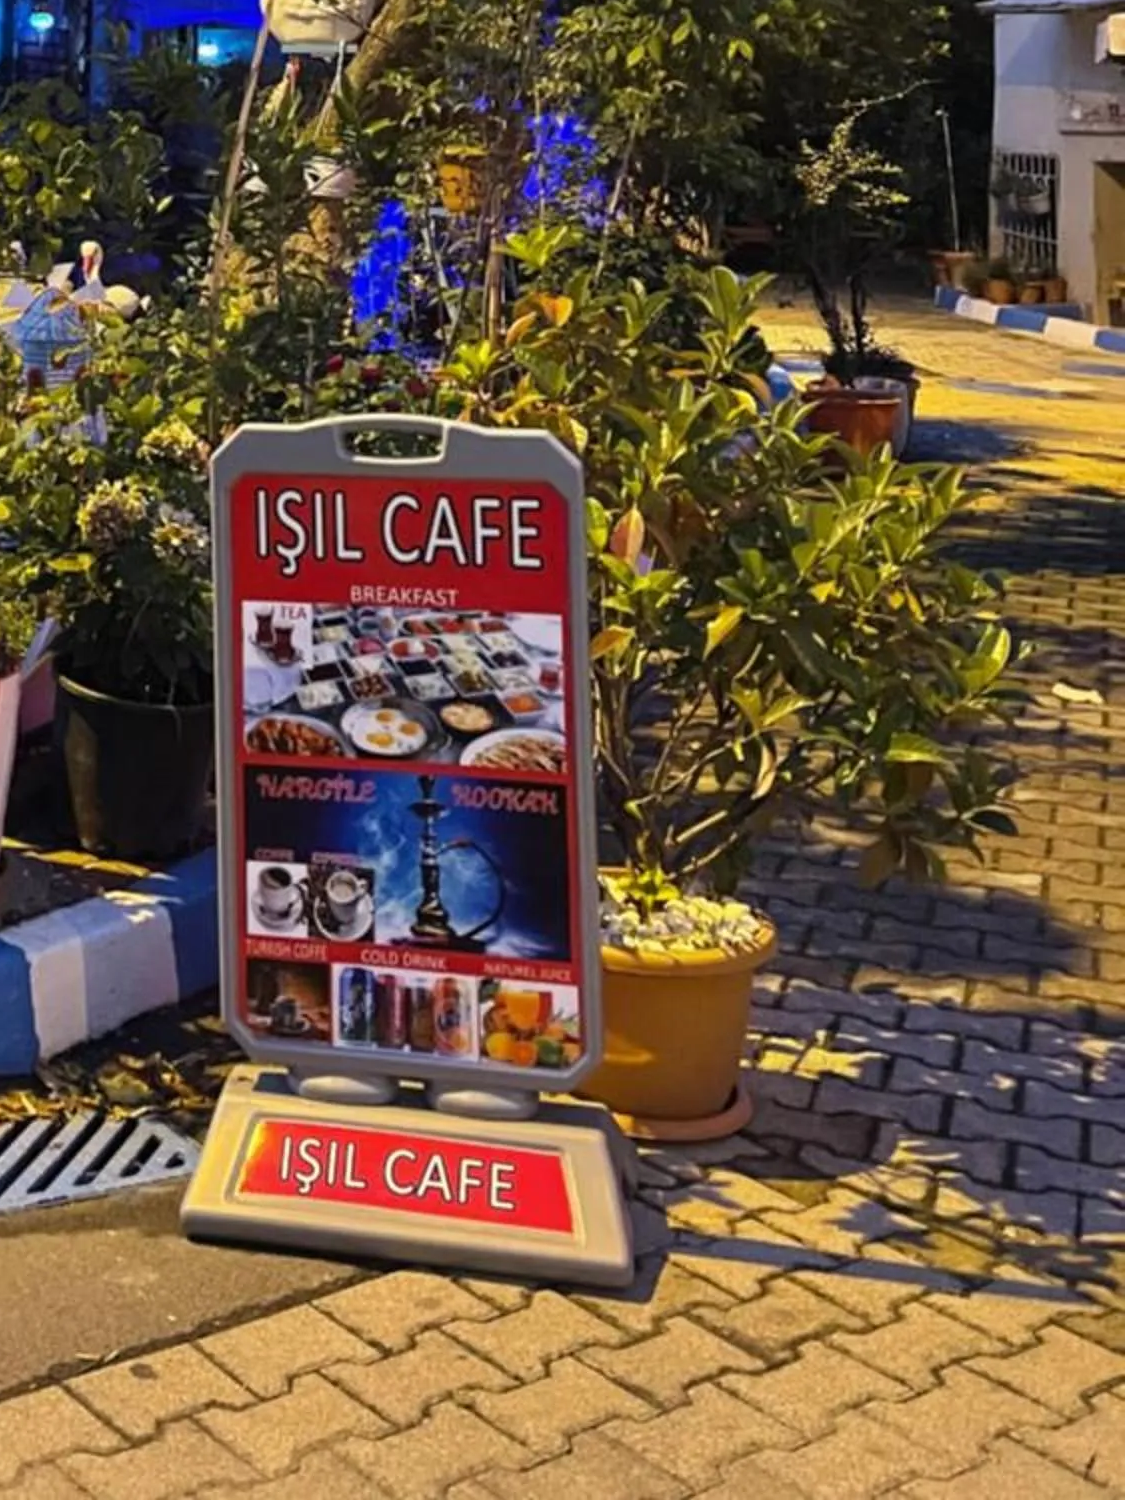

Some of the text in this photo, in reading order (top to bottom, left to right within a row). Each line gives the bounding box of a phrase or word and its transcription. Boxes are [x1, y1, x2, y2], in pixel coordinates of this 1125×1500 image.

[255, 488, 545, 577] IŞIL CAFE
[349, 584, 459, 607] BREAKFAST
[280, 605, 308, 621] TEA
[450, 782, 559, 815] HOOKAH
[360, 947, 448, 970] COLD DRINK
[280, 1135, 516, 1211] IŞIL CAFE
